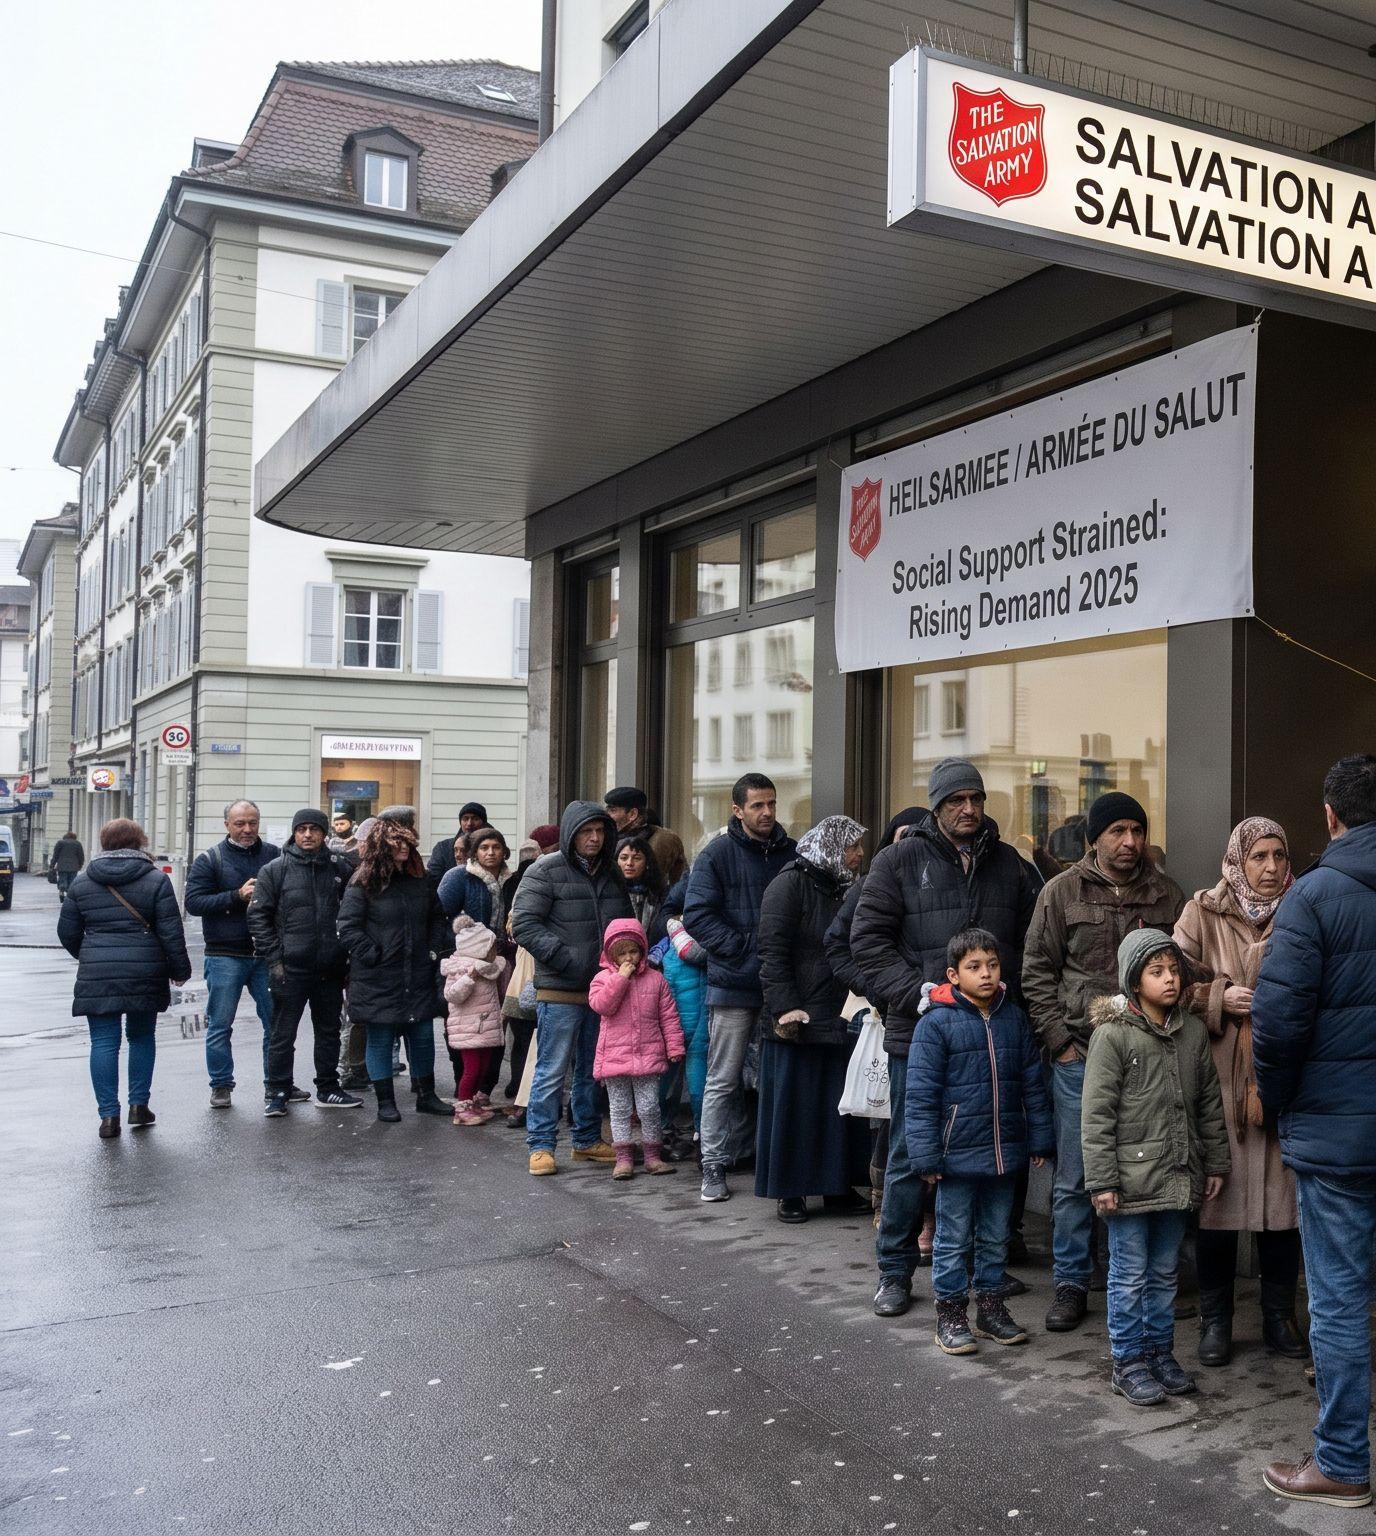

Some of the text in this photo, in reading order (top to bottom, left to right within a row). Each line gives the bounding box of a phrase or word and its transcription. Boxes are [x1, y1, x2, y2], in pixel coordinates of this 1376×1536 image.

[956, 115, 1037, 165] SALVATION
[969, 100, 1004, 130] THE
[984, 147, 1033, 187] ARMY
[1075, 116, 1334, 224] SALVATION
[1074, 178, 1331, 279] SALVATION
[888, 448, 1009, 517] HEILSARMEE
[1014, 443, 1023, 483] /
[1025, 412, 1106, 478] ARMÉE
[1113, 404, 1147, 452] DU
[1154, 371, 1246, 439] SALUT
[892, 498, 1168, 594] Social Support Strained:
[909, 562, 1139, 641] Rising Demand 2025
